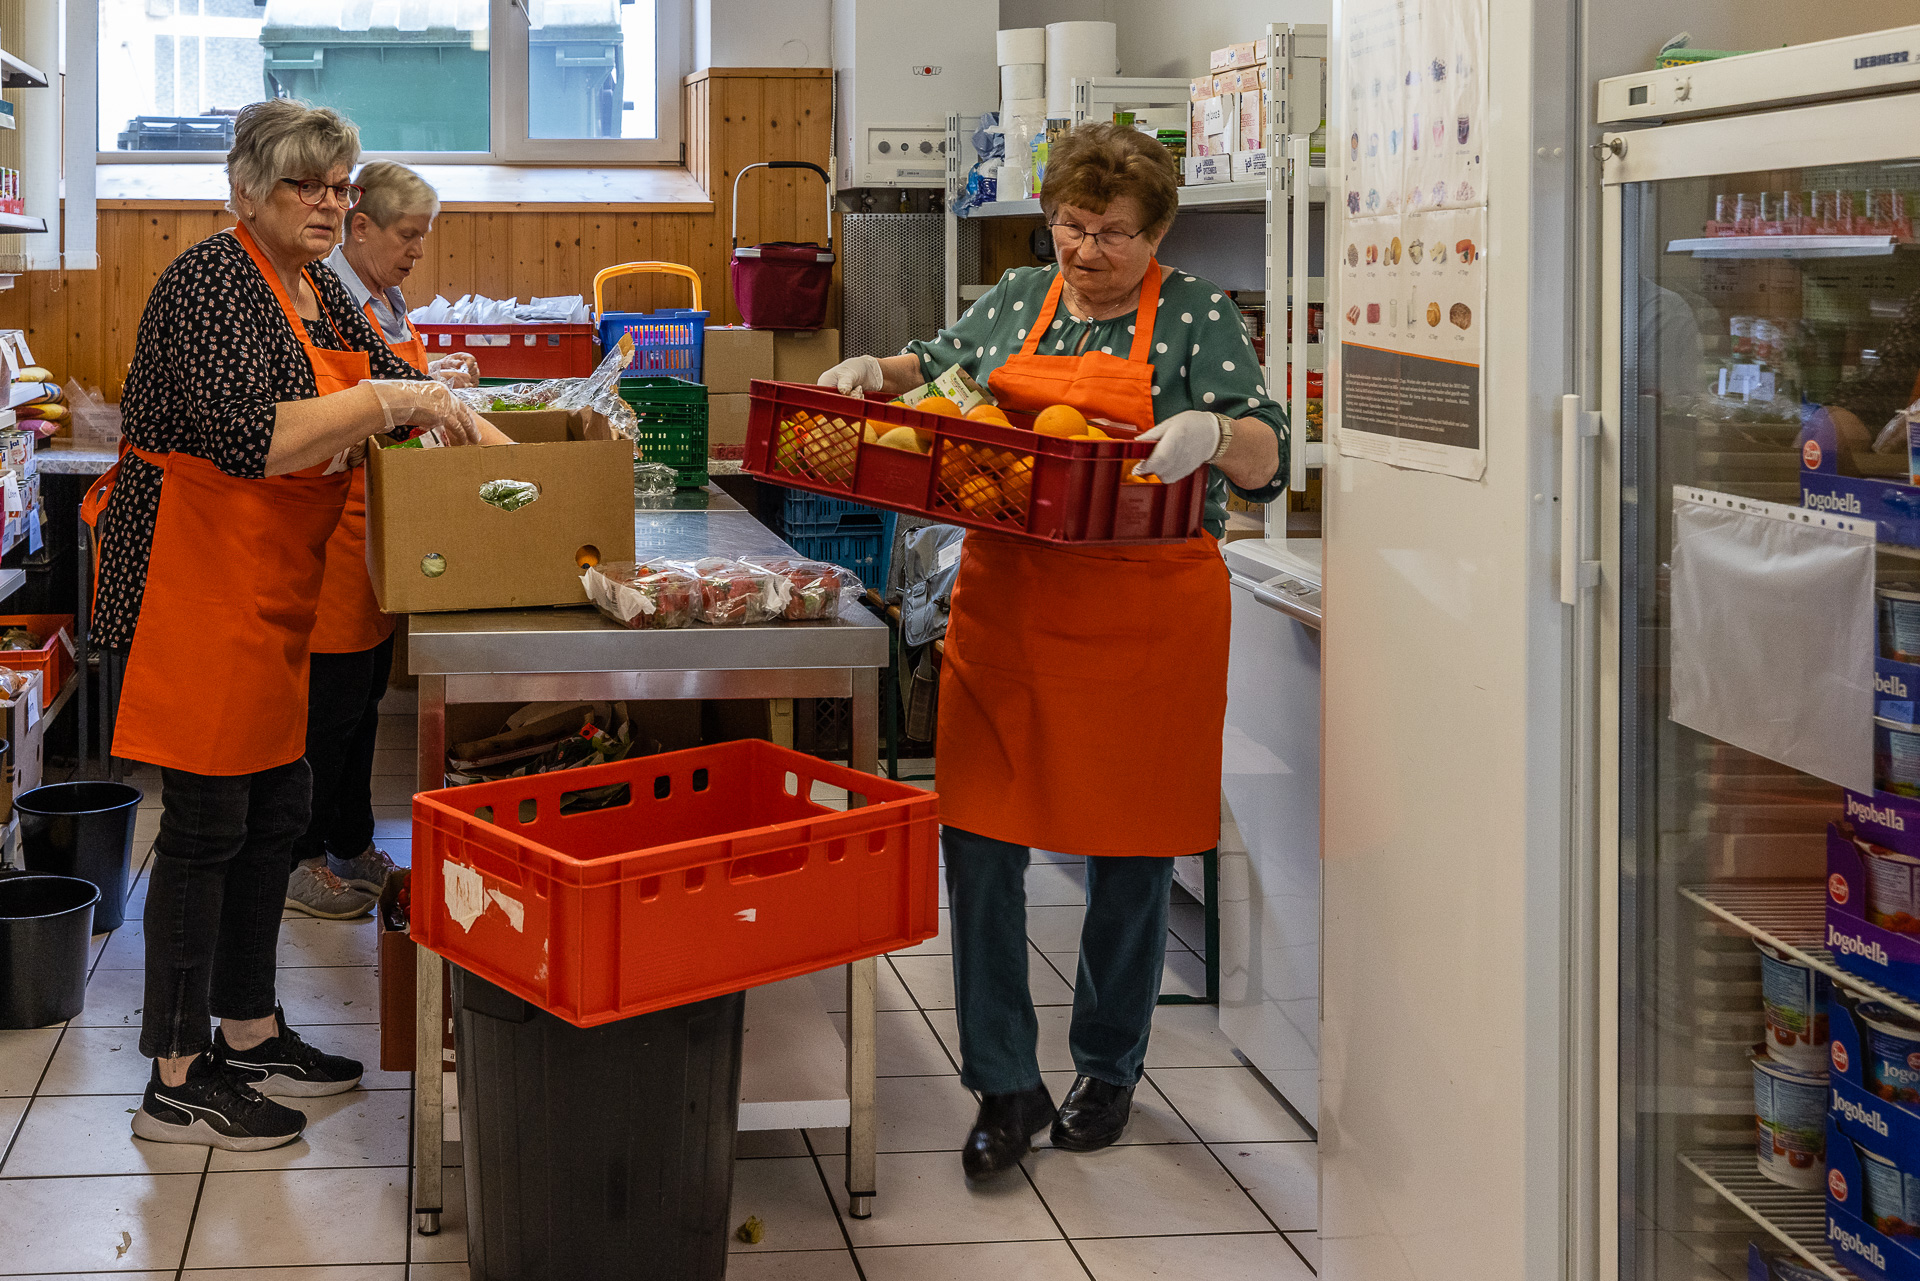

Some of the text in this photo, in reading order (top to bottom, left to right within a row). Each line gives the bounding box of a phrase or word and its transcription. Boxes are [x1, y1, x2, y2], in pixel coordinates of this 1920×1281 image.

[1854, 51, 1909, 69] LIEBHERR
[10, 440, 19, 449] ja!
[1803, 488, 1861, 515] Jogobella
[1873, 671, 1907, 698] bella
[1846, 794, 1904, 831] Jogobella
[1826, 924, 1889, 967] Jogobella
[1831, 1088, 1889, 1137] Jogobella
[1827, 1217, 1886, 1271] Jogobella
